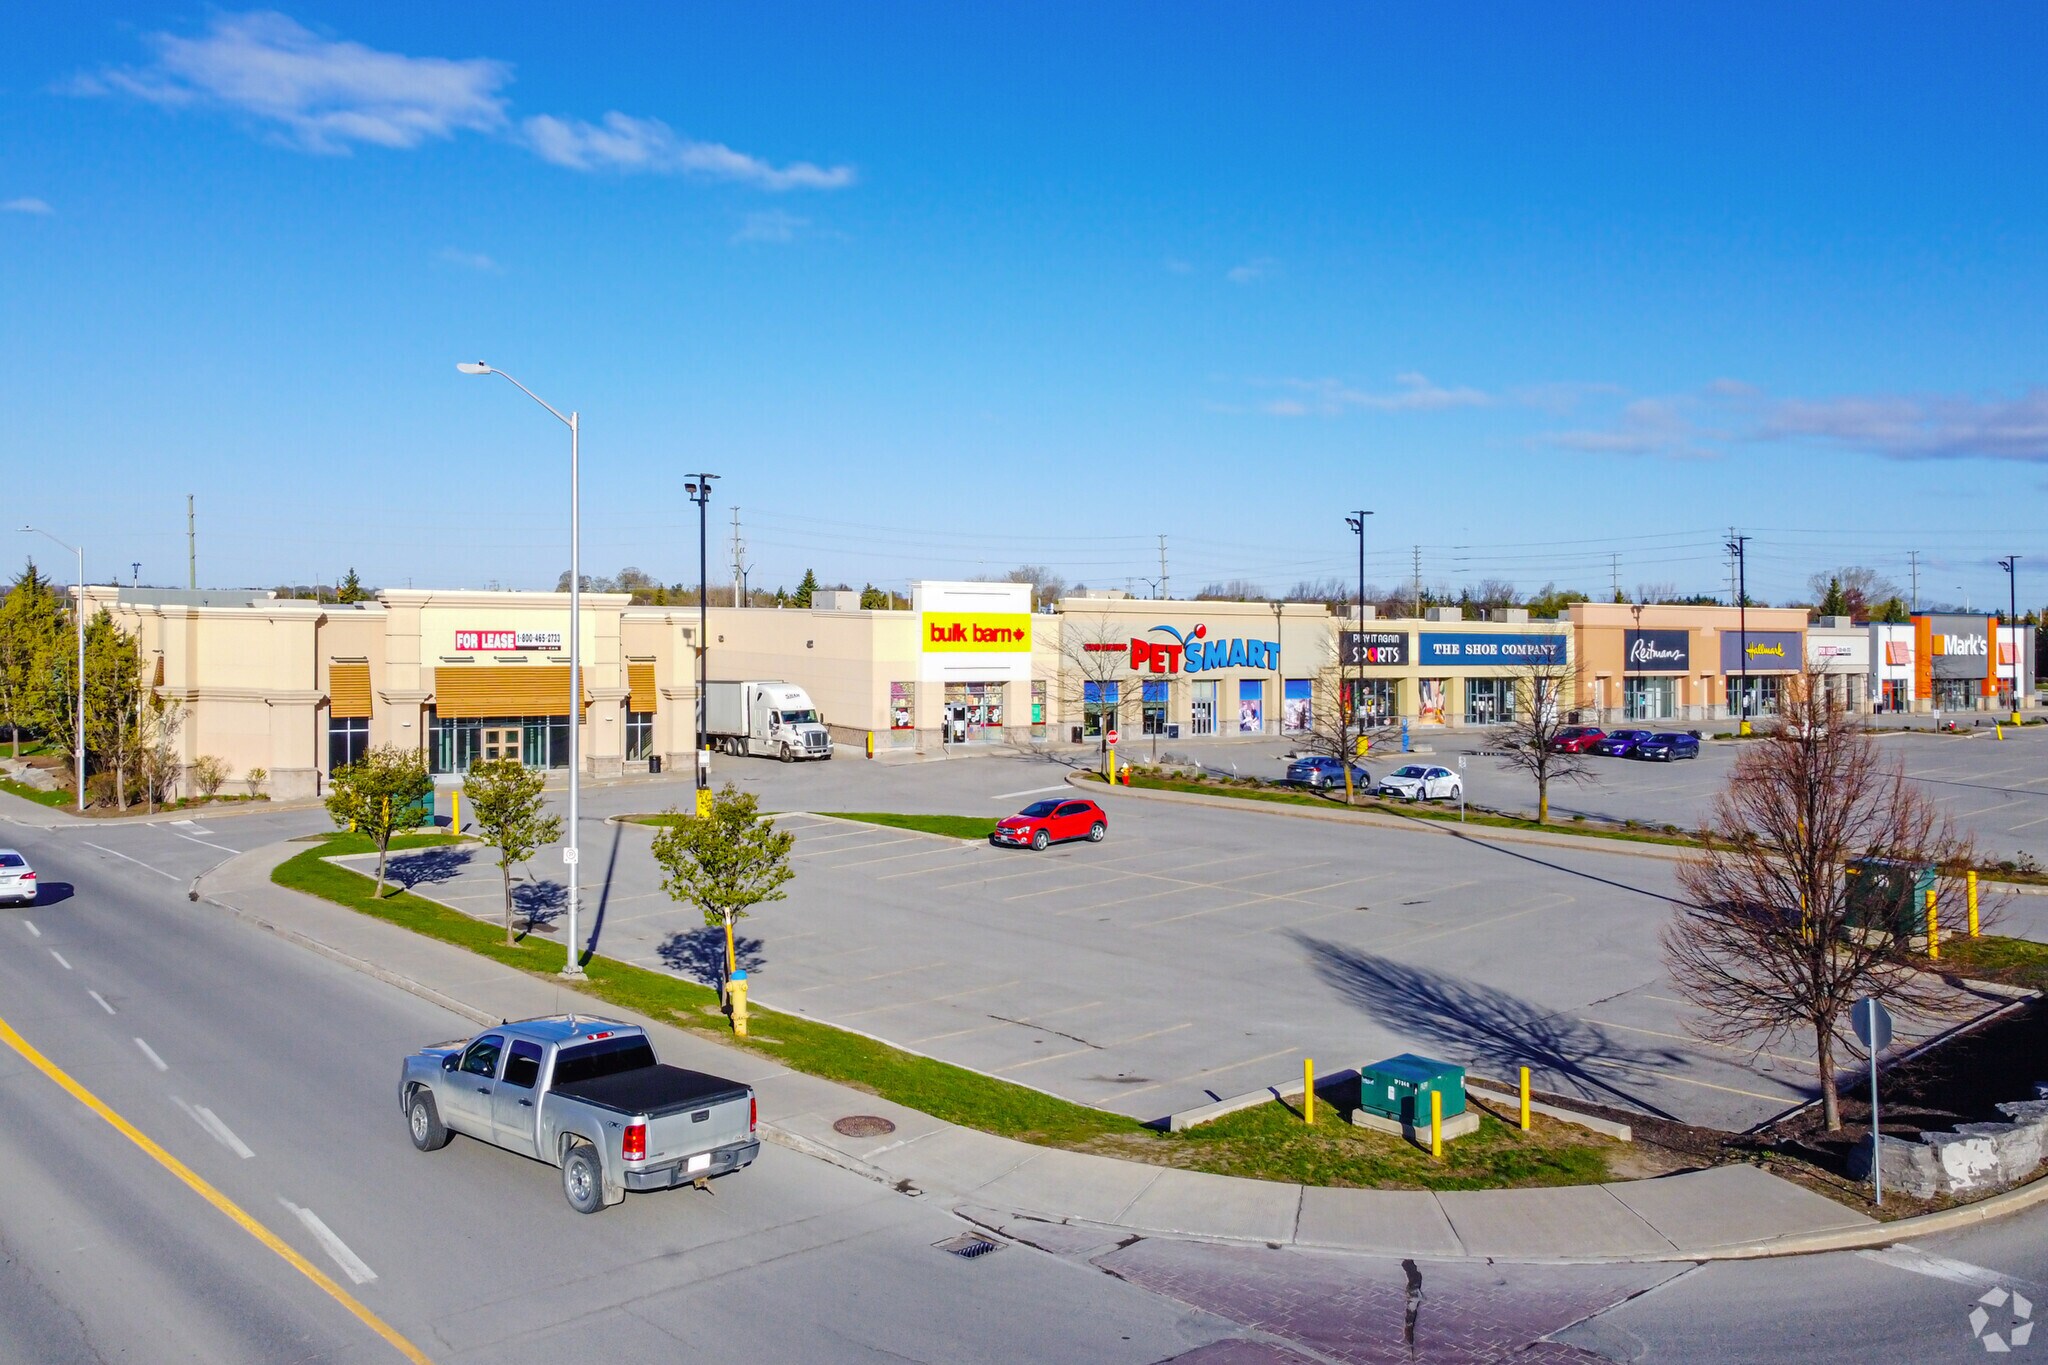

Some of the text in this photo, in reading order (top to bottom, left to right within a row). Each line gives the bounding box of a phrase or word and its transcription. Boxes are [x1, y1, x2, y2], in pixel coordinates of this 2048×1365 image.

[456, 633, 515, 649] FOR LEASE
[930, 623, 1012, 642] bulk barn
[1371, 634, 1378, 643] IT
[1378, 635, 1399, 643] AGAIN
[1433, 643, 1557, 656] THE SHOE COMPANY
[1631, 638, 1685, 662] Reitmans
[1745, 641, 1785, 660] Hallmark
[1944, 634, 1987, 655] Mark's
[1130, 637, 1281, 674] PETSMART
[1352, 646, 1399, 663] SPORTS
